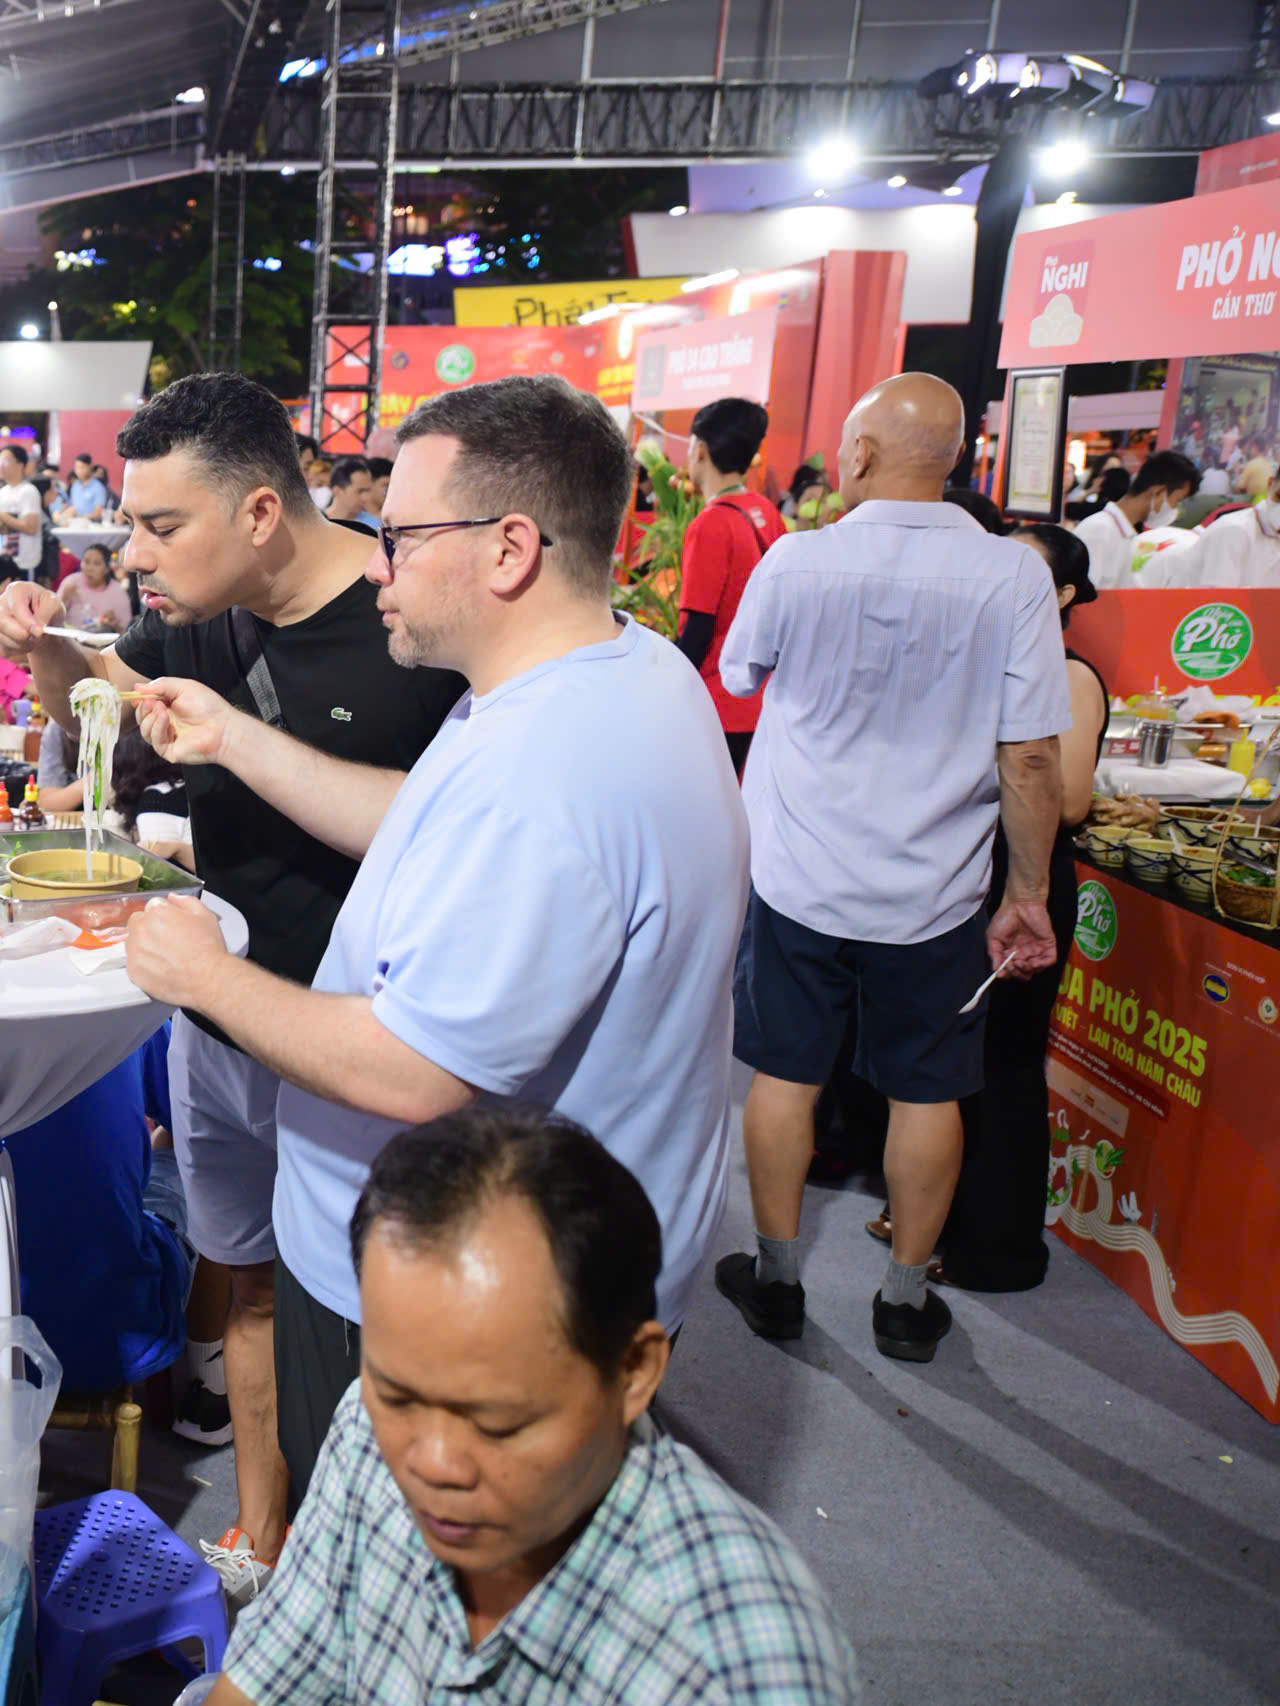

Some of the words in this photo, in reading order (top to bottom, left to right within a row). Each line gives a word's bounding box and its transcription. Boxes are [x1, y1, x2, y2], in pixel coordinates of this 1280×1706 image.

[1040, 261, 1089, 294] NGHI
[1176, 224, 1247, 291] PHỞ
[1177, 616, 1244, 653] Phở
[1077, 890, 1113, 932] Phở
[1089, 977, 1140, 1034] PHỞ
[1143, 1009, 1208, 1078] 2025
[1088, 1023, 1111, 1051] LAN
[1166, 1072, 1202, 1109] CHÂU
